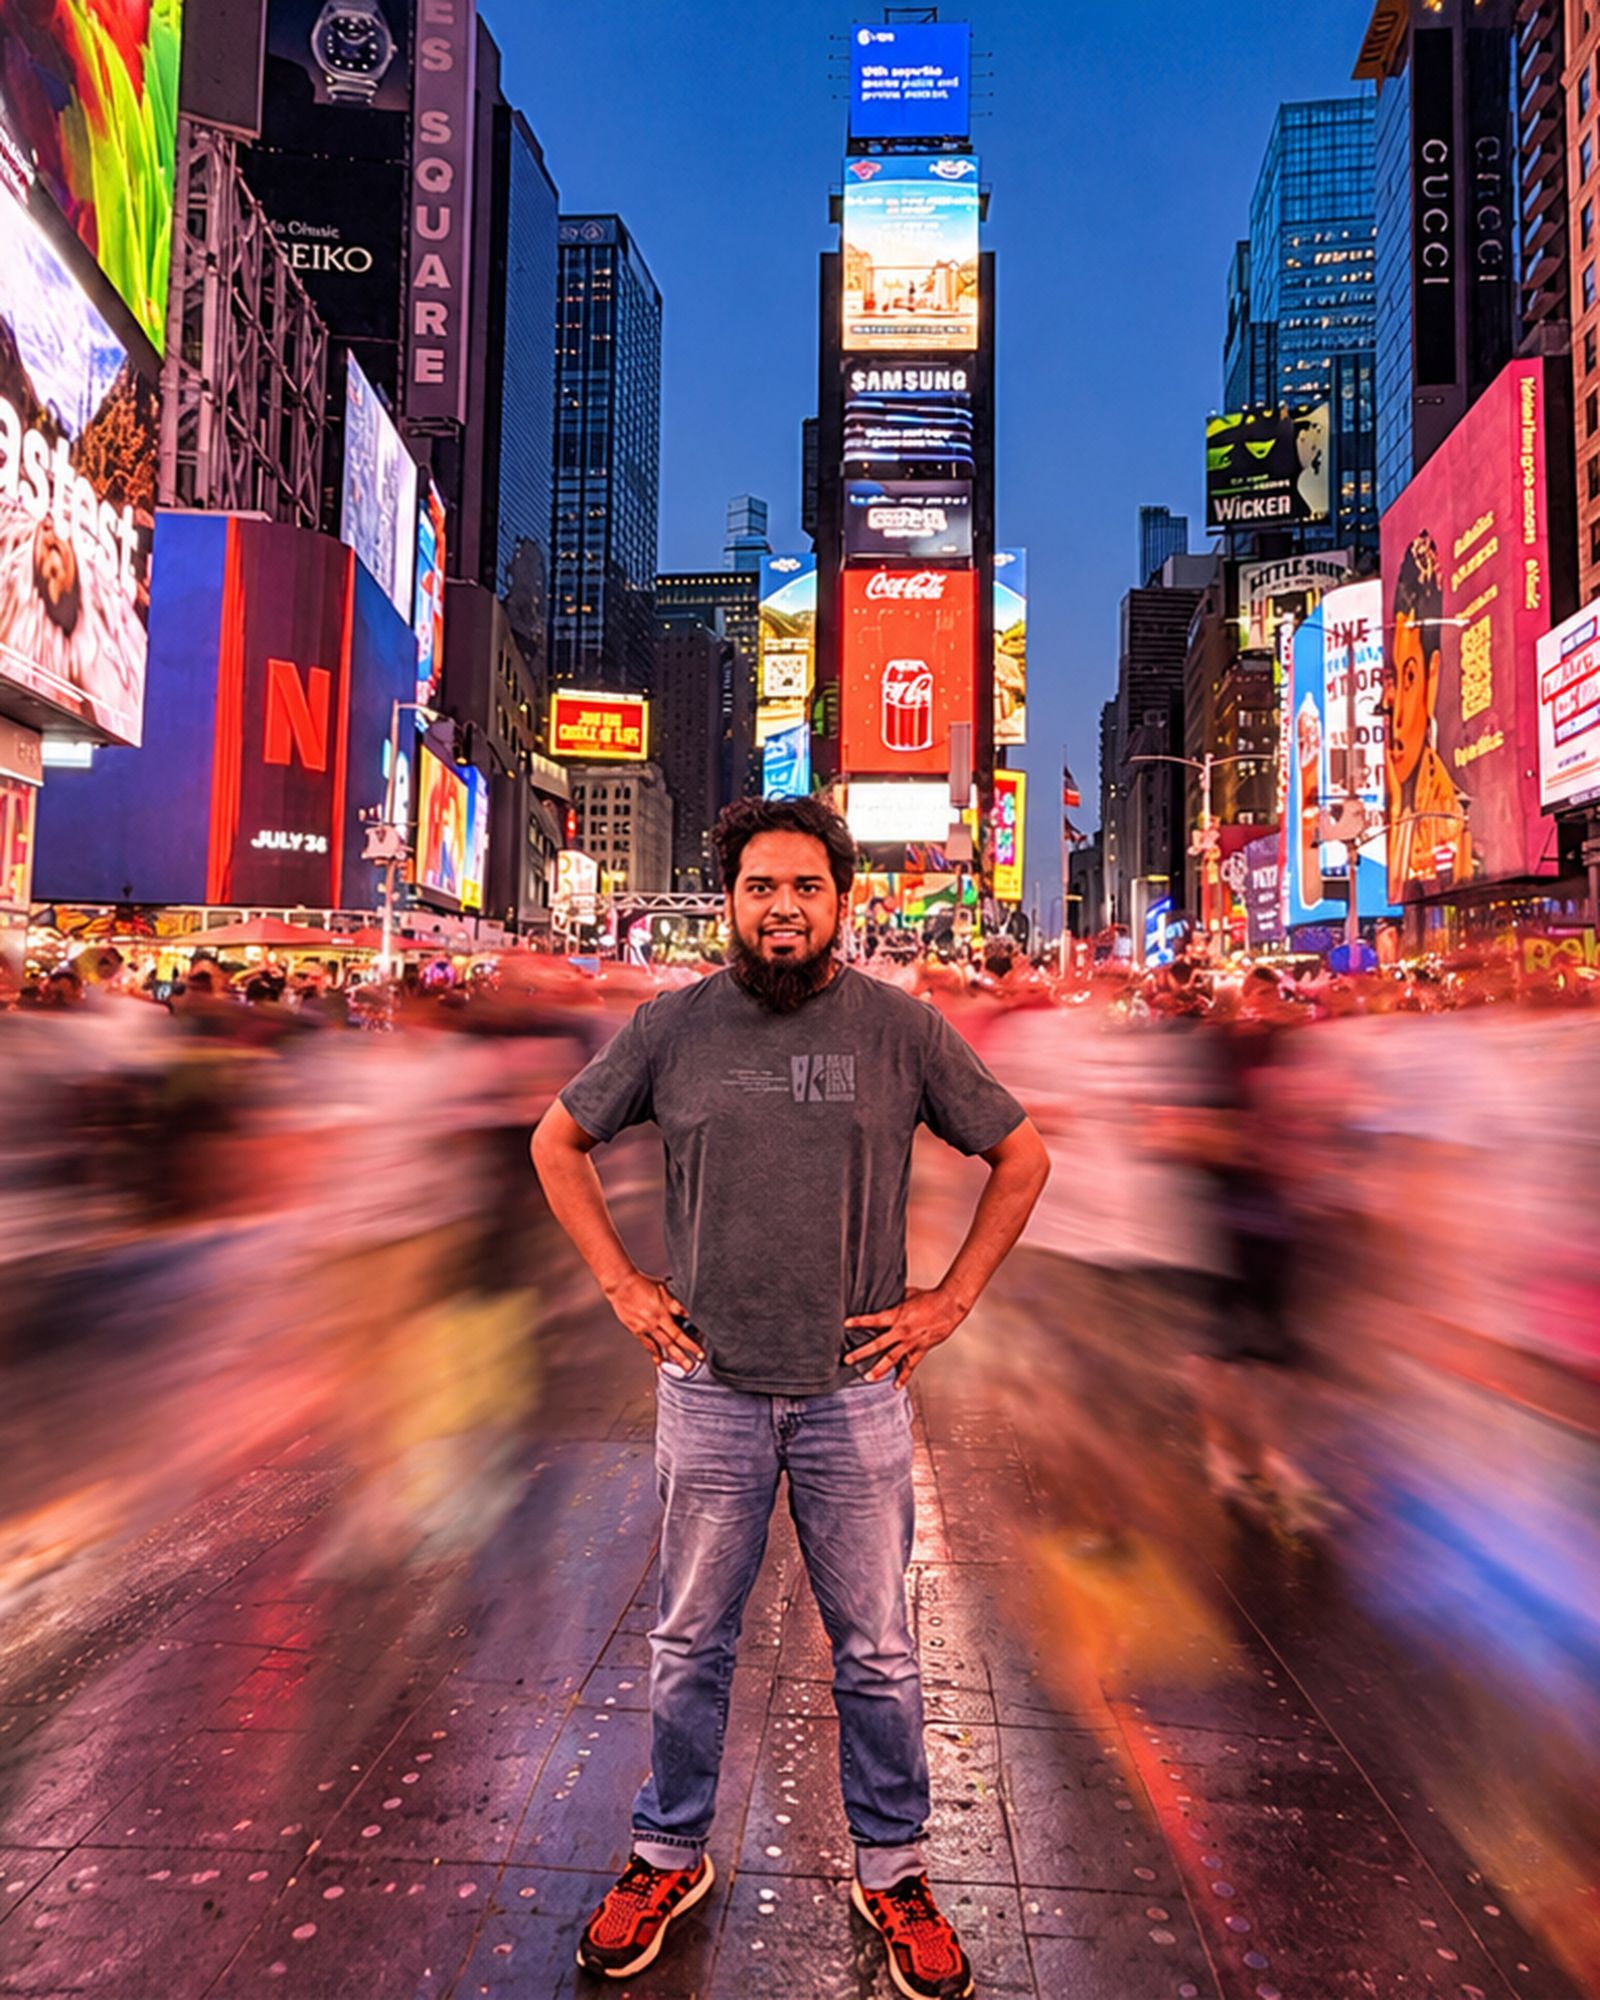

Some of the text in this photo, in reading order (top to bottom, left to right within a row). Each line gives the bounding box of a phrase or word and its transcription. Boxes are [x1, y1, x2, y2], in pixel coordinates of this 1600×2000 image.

[413, 111, 453, 383] SQUARE
[851, 370, 967, 391] SAMSUNG
[263, 658, 331, 771] N
